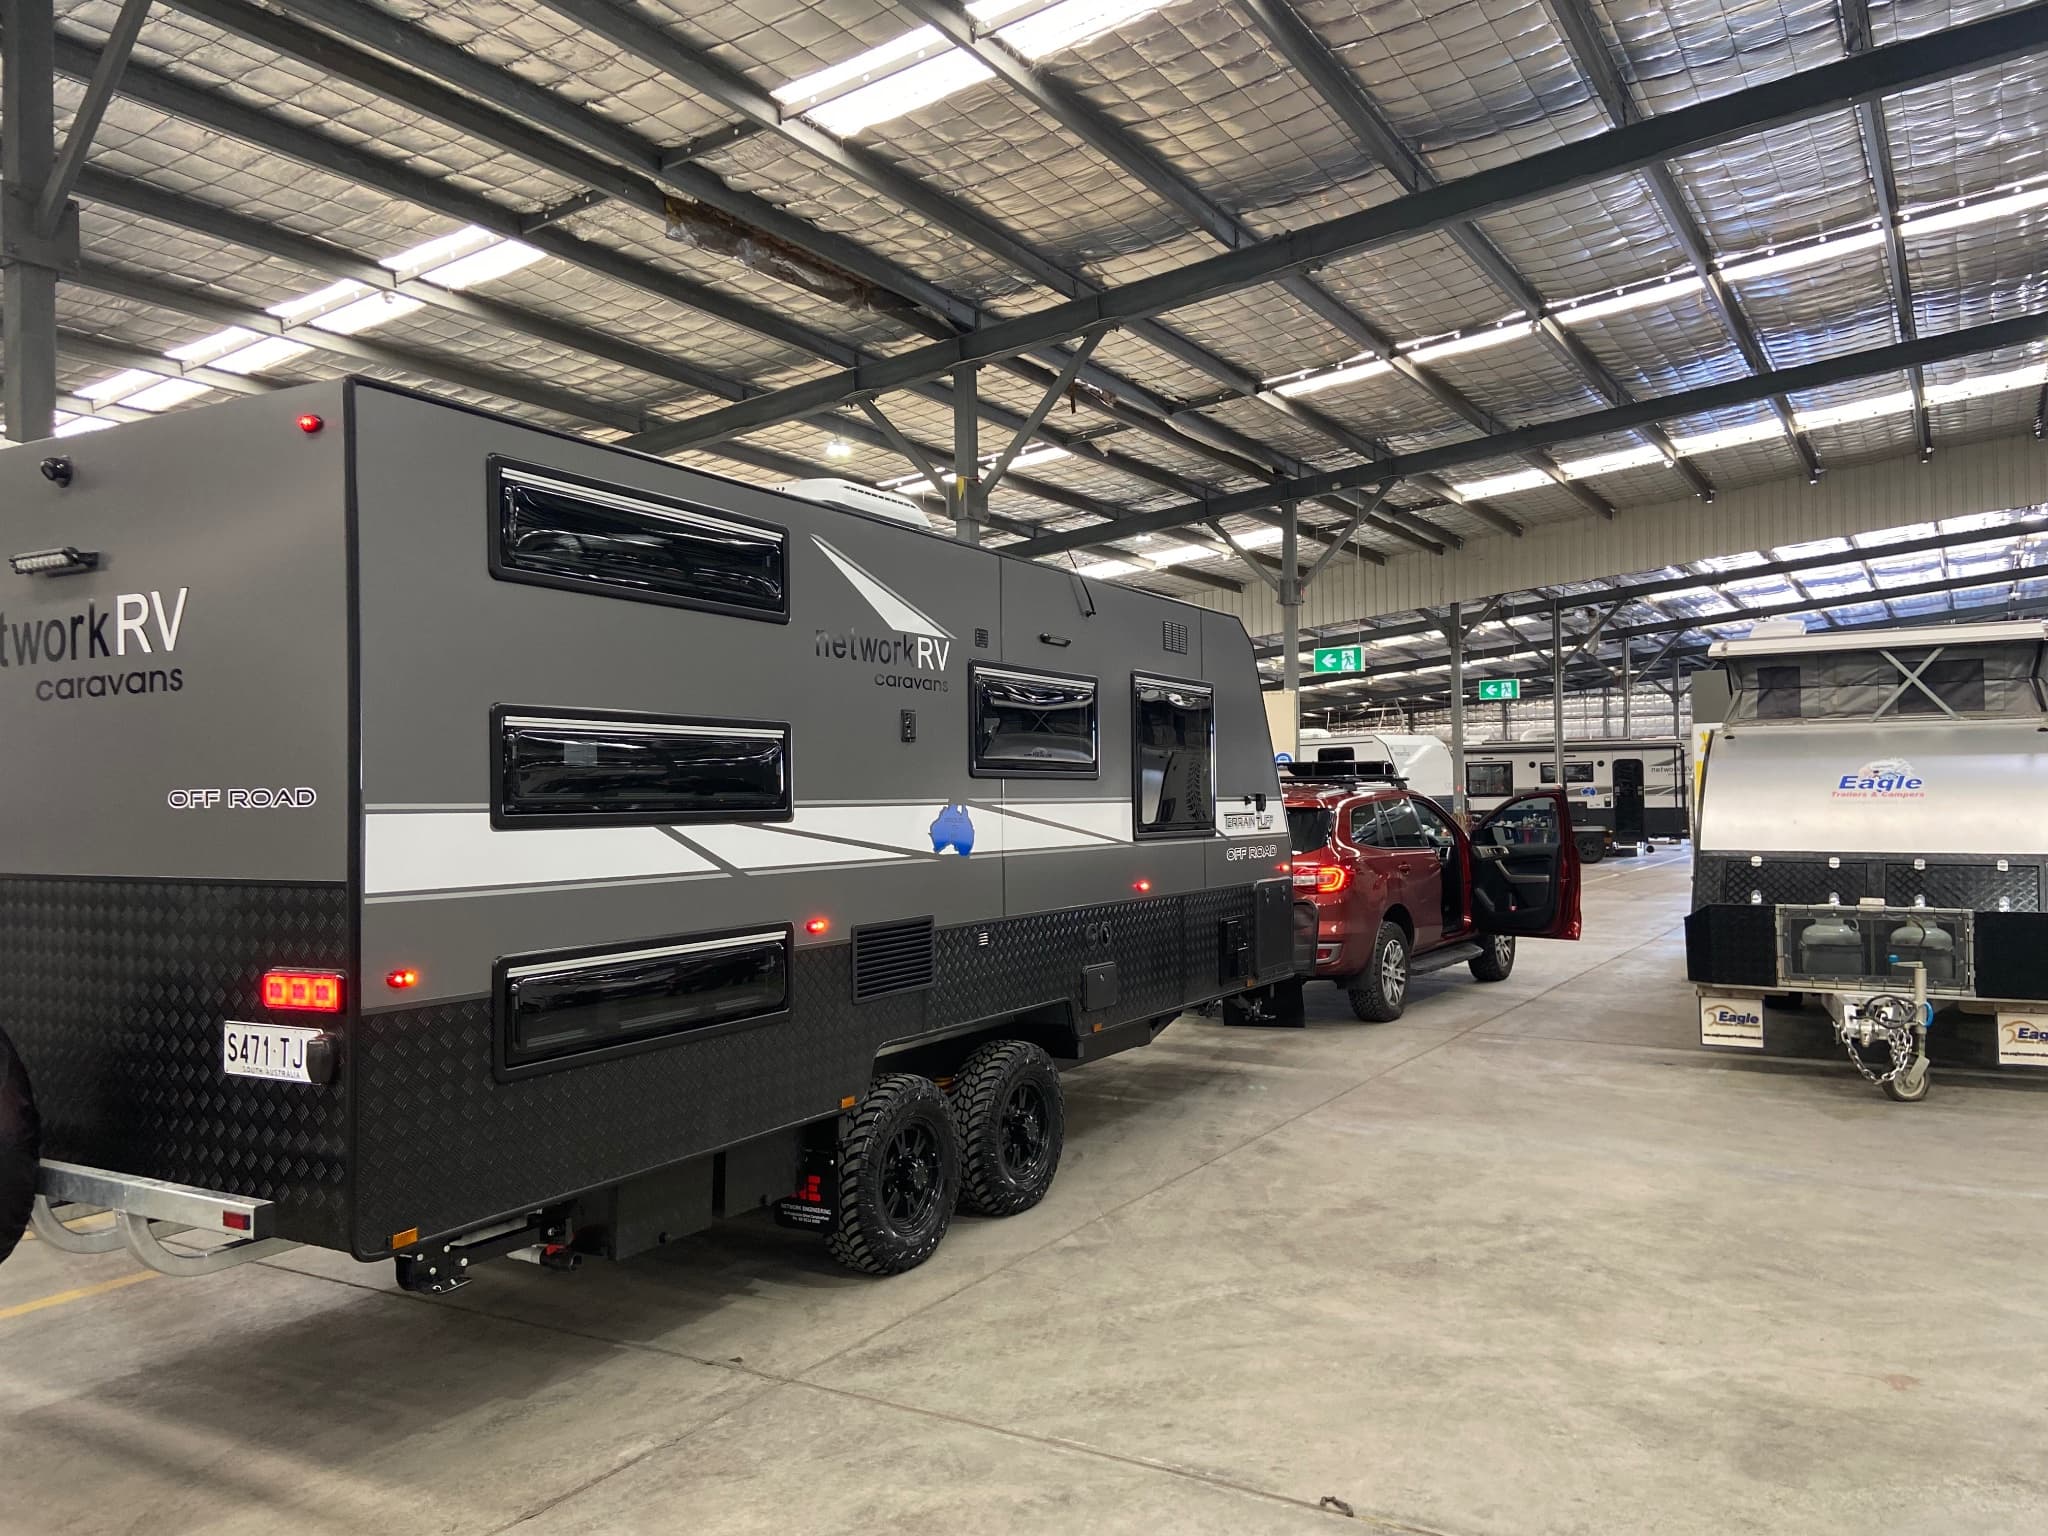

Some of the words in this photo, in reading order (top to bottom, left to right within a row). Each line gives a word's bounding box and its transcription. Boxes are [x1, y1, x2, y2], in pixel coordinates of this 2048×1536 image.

[815, 629, 950, 672] networkRV
[36, 667, 184, 701] caravans
[874, 672, 949, 693] caravans
[1838, 775, 1922, 793] Eagle
[168, 789, 221, 809] OFF
[227, 787, 317, 809] ROAD
[1226, 846, 1248, 861] OFF
[1248, 844, 1278, 859] ROAD
[1719, 1011, 1759, 1025] Eagle
